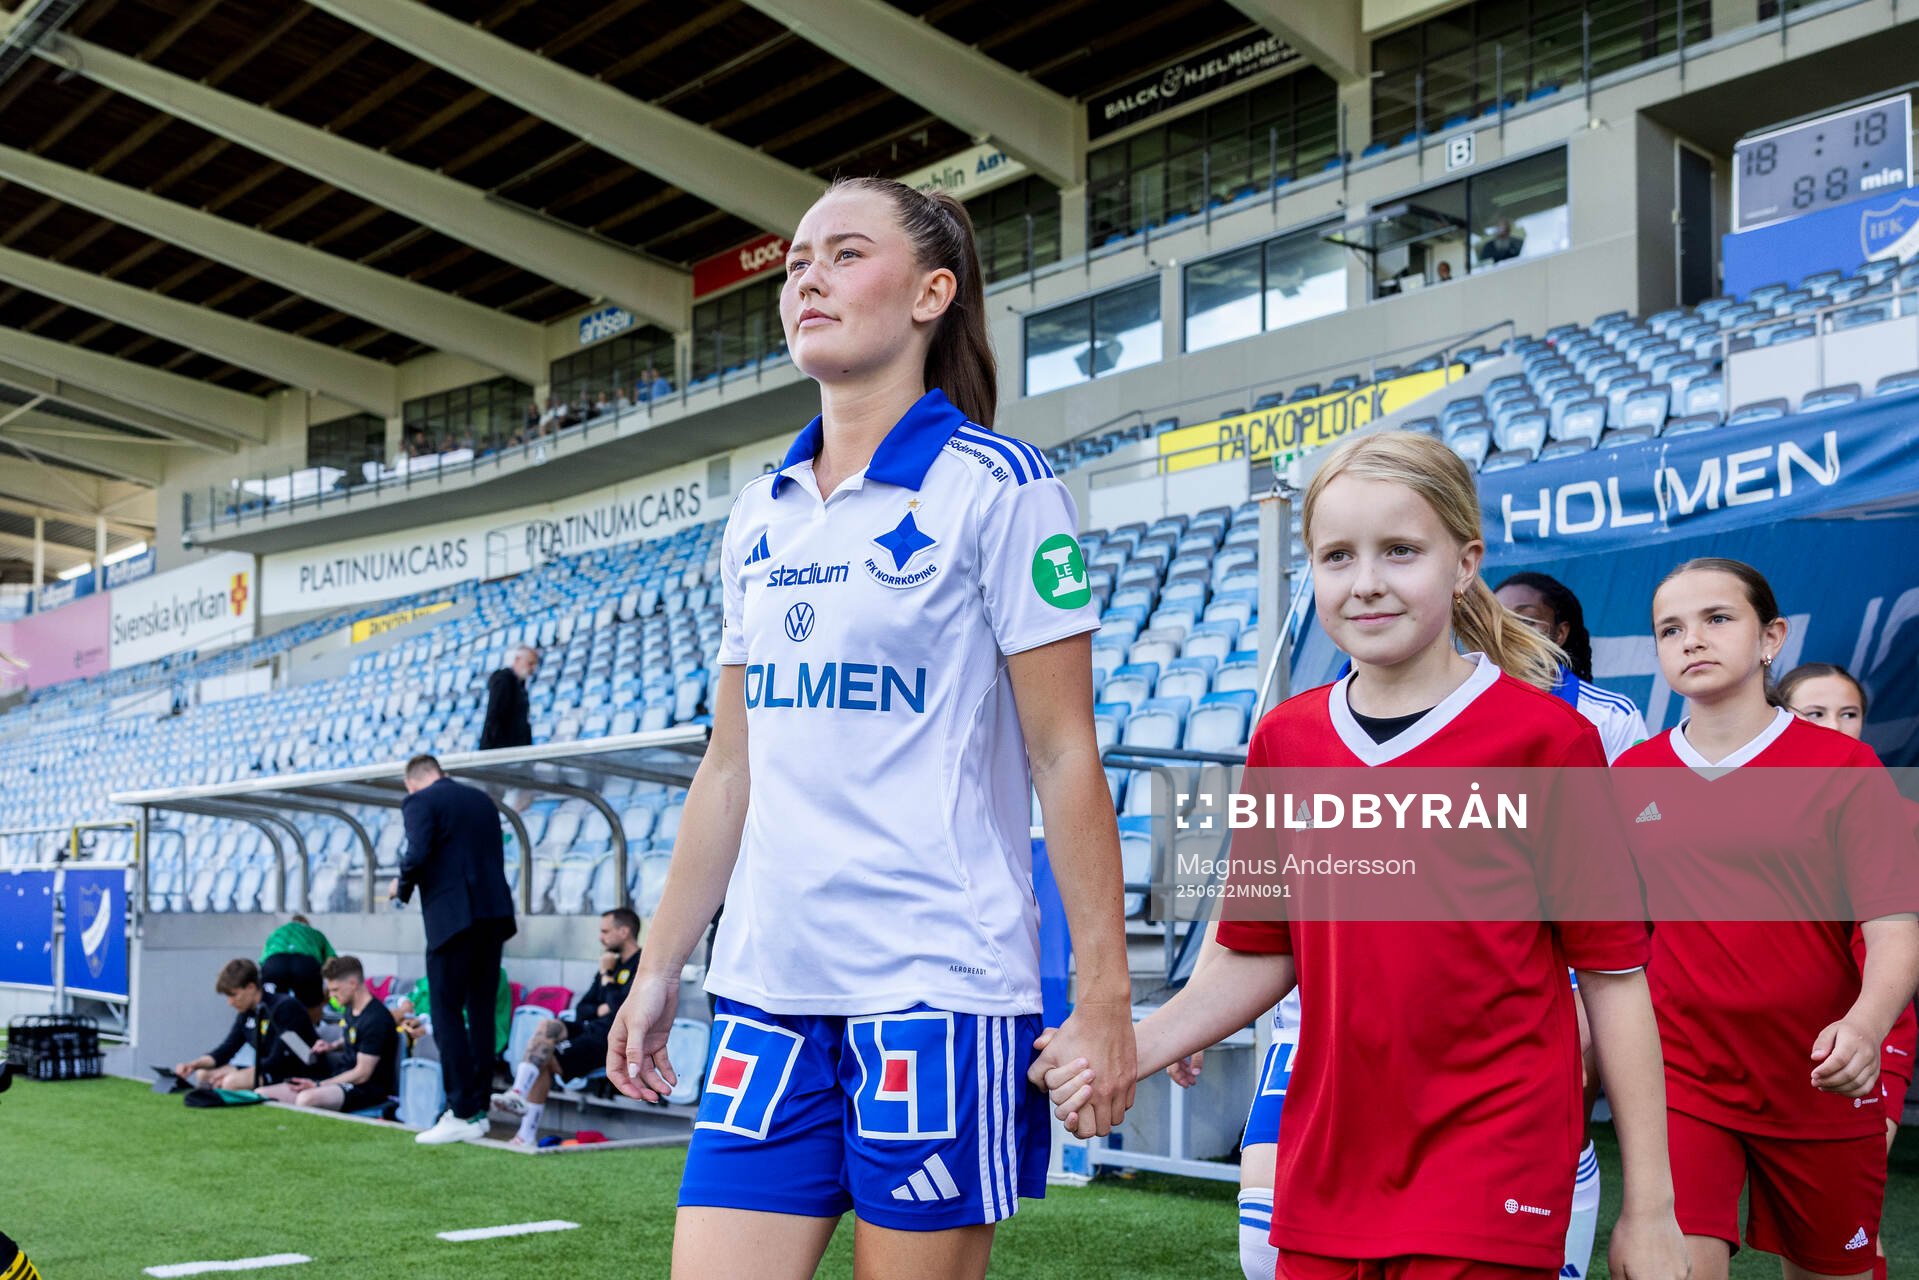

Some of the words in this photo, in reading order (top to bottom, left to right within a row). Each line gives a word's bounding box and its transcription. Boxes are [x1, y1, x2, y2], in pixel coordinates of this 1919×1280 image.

[1105, 85, 1159, 119] BALCK
[1160, 64, 1185, 97] &
[1854, 112, 1887, 147] 18
[1451, 139, 1470, 167] B
[1860, 167, 1904, 191] min
[1870, 217, 1904, 240] IFK
[1218, 388, 1388, 462] PACKOPLOCK
[991, 466, 1008, 483] Bil
[1501, 431, 1840, 543] HOLMEN
[300, 538, 468, 593] PLATINUMCARS
[767, 561, 849, 587] stadium
[865, 558, 878, 573] IFK
[875, 564, 937, 585] NORRKÖPING
[1055, 564, 1072, 578] LE
[113, 600, 171, 645] Svenska
[172, 585, 227, 636] kyrkan
[746, 662, 926, 713] OLMEN
[949, 965, 986, 975] AEROREADY
